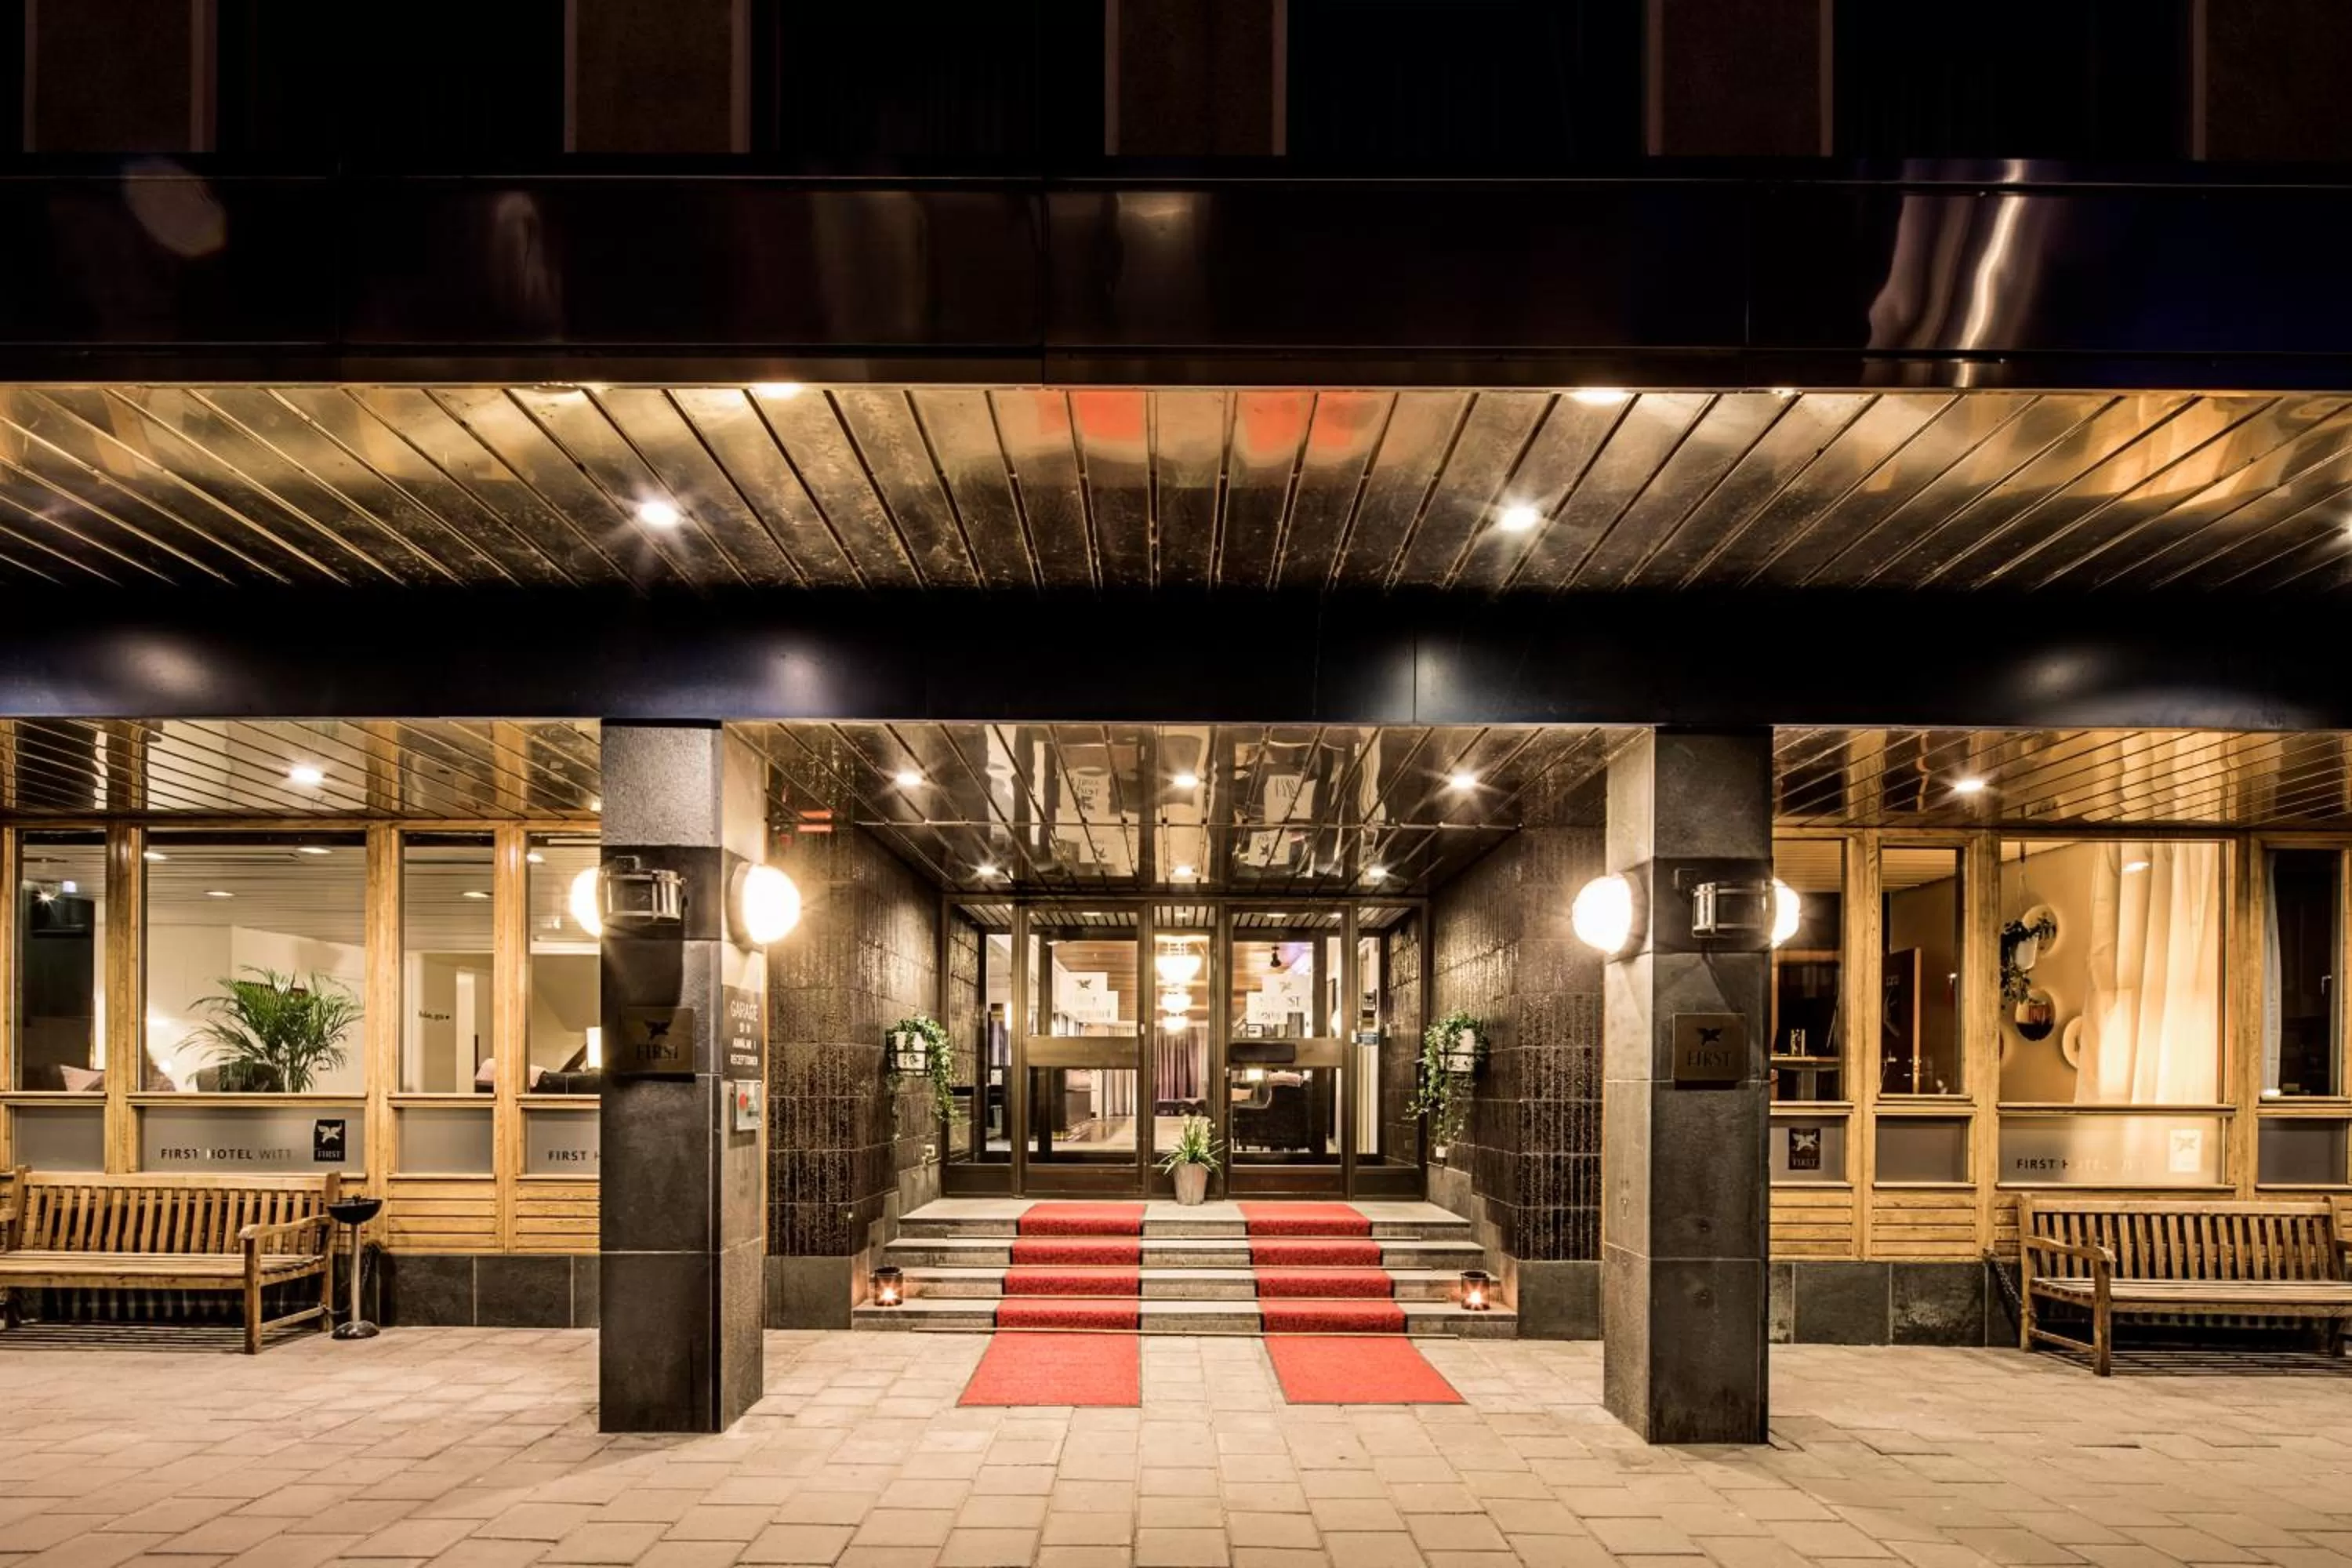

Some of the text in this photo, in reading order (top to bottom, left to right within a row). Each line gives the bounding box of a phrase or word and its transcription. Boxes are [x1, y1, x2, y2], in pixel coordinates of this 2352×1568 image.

[730, 1000, 758, 1022] GARAGE
[1688, 1051, 1731, 1067] FIRST
[161, 1149, 199, 1160] FIRST
[318, 1150, 342, 1159] FIRST
[548, 1150, 586, 1161] FIRST
[2016, 1158, 2055, 1170] FIRST
